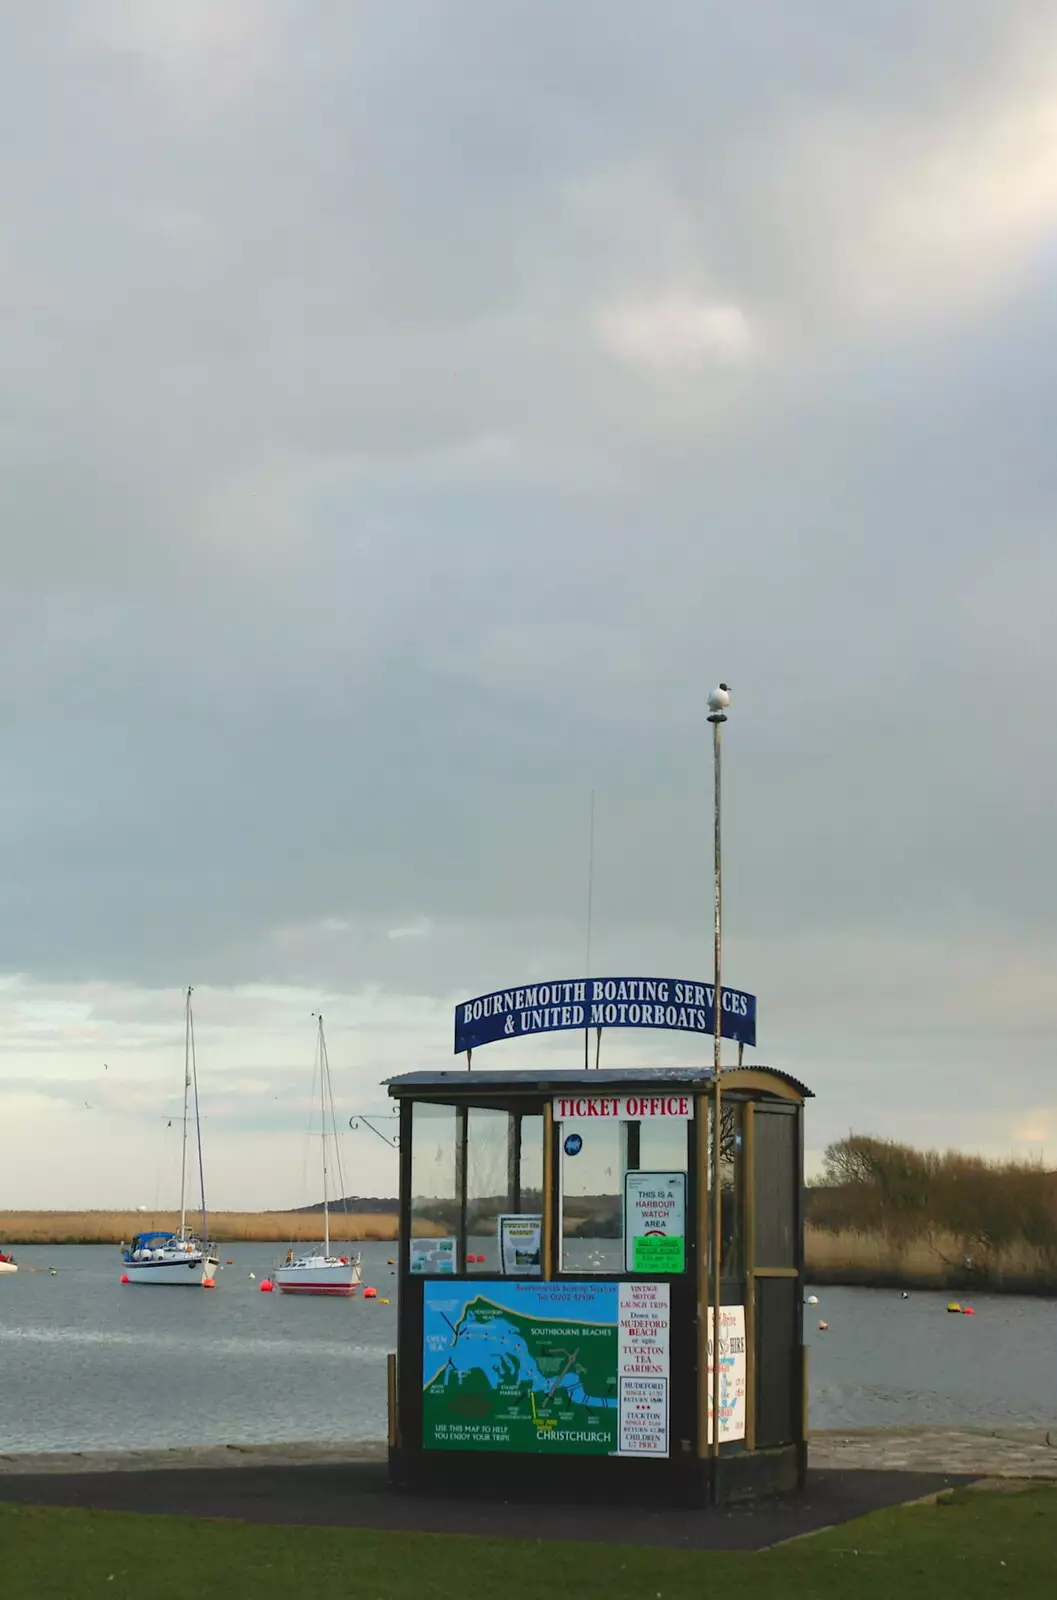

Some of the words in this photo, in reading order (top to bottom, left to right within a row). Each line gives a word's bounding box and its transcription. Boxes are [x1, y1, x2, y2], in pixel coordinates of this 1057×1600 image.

[463, 982, 585, 1024] BOURNEMOUTH
[592, 980, 669, 1002] BOATING
[675, 983, 748, 1016] SERVCES
[503, 1015, 515, 1035] &
[521, 1005, 584, 1031] UNITED
[590, 1004, 706, 1030] MOTORBOATS
[558, 1098, 620, 1117] TICKET
[626, 1097, 688, 1116] OFFICE
[644, 1220, 666, 1228] AREA
[620, 1320, 667, 1329] MUDEFORD
[531, 1328, 579, 1336] SOUTHBOURNE
[582, 1328, 611, 1336] BEACHES
[628, 1328, 657, 1336] BEACH
[730, 1337, 744, 1354] HIRE
[623, 1346, 664, 1354] TUCKTON
[634, 1355, 651, 1363] TEA
[624, 1364, 663, 1373] GARDENS
[627, 1412, 661, 1420] TUCKTON
[435, 1424, 447, 1432] USE
[449, 1424, 463, 1432] THIS
[536, 1431, 611, 1442] CHRISTCHURCH
